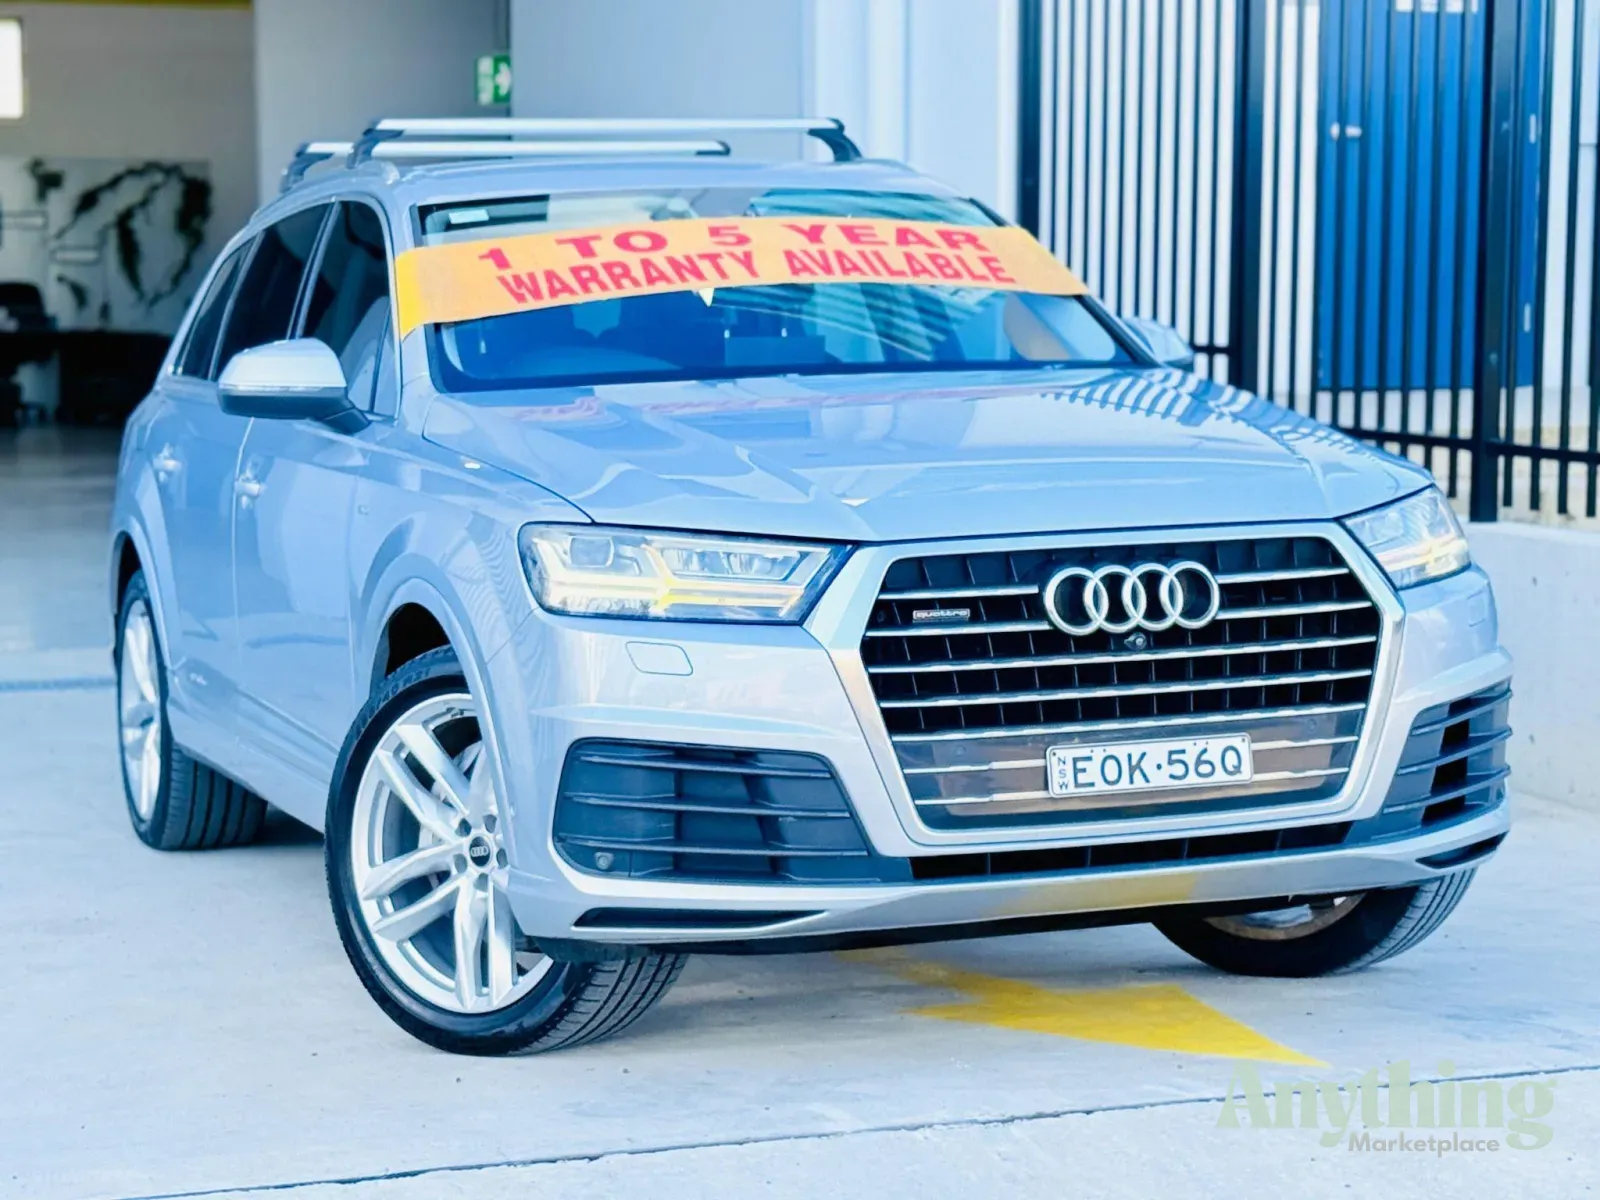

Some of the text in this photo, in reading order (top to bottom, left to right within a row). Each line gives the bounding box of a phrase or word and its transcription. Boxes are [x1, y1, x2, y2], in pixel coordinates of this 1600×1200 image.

[478, 223, 991, 271] 1 TO 5 YEAR
[496, 249, 1016, 305] WARRANTY AVAILABLE
